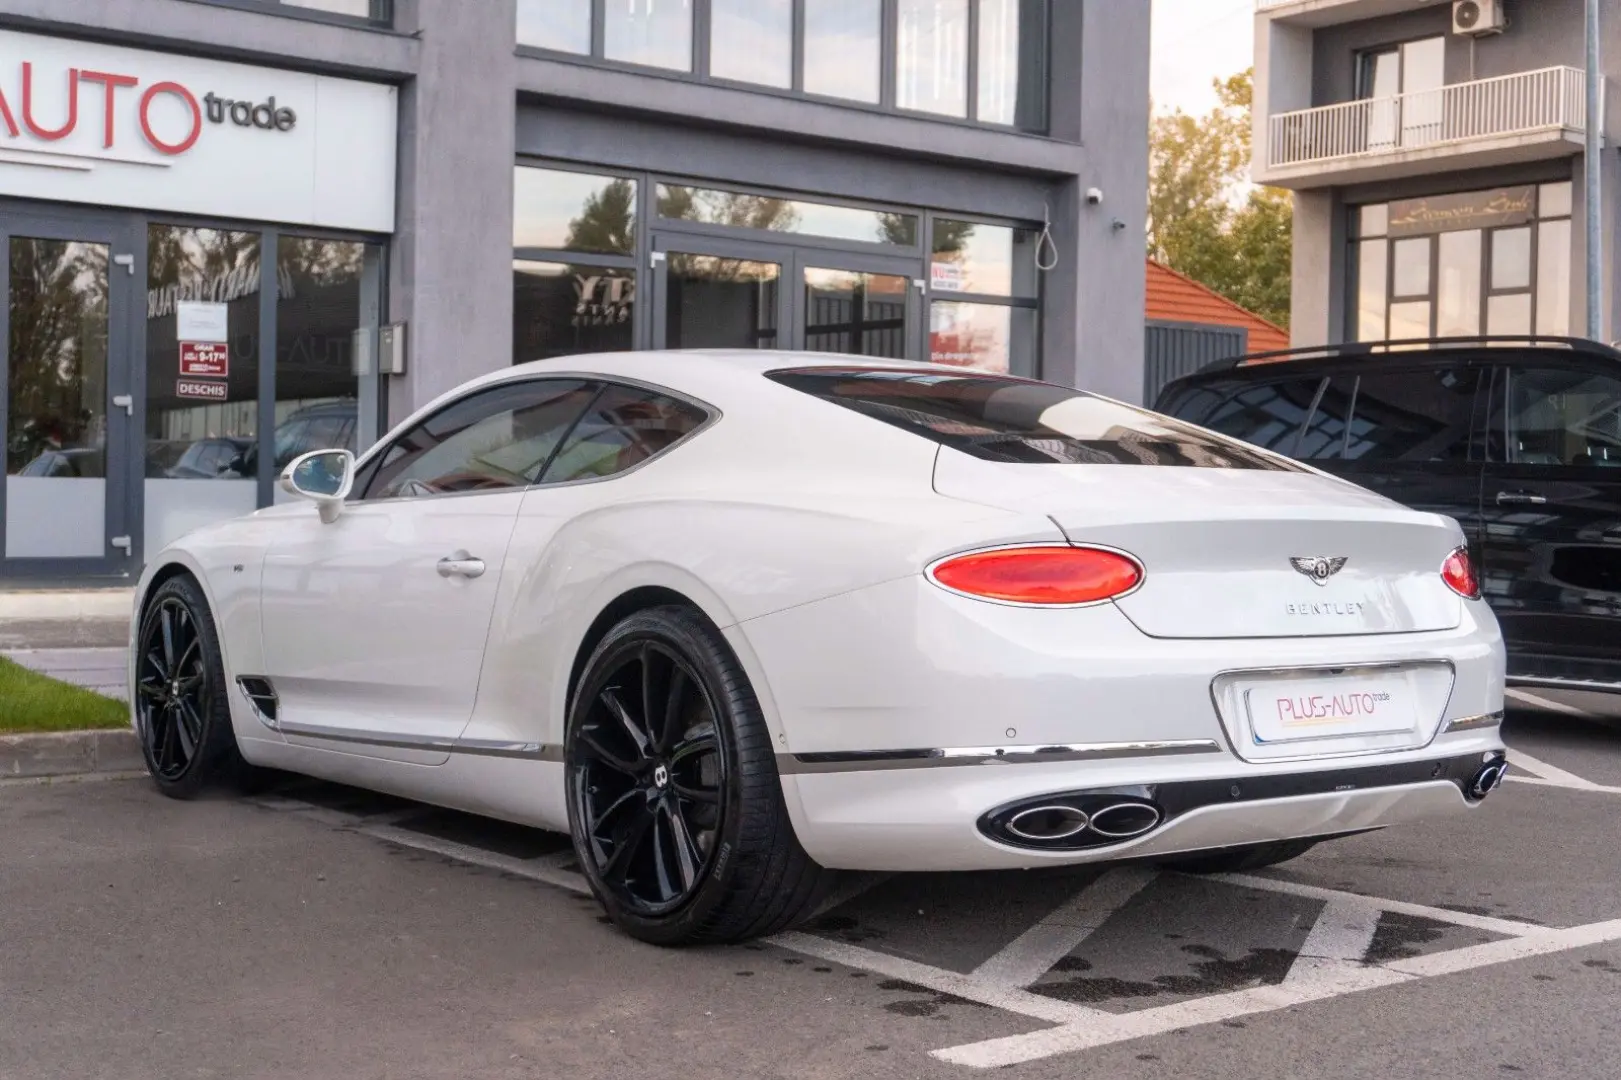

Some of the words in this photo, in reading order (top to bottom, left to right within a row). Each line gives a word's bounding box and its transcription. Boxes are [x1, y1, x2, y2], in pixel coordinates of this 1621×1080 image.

[204, 91, 297, 132] trade
[180, 384, 225, 396] DESCHIS
[1285, 602, 1364, 616] BENTLEY
[1276, 693, 1375, 721] PLUS-AUTO
[1372, 691, 1391, 702] trade
